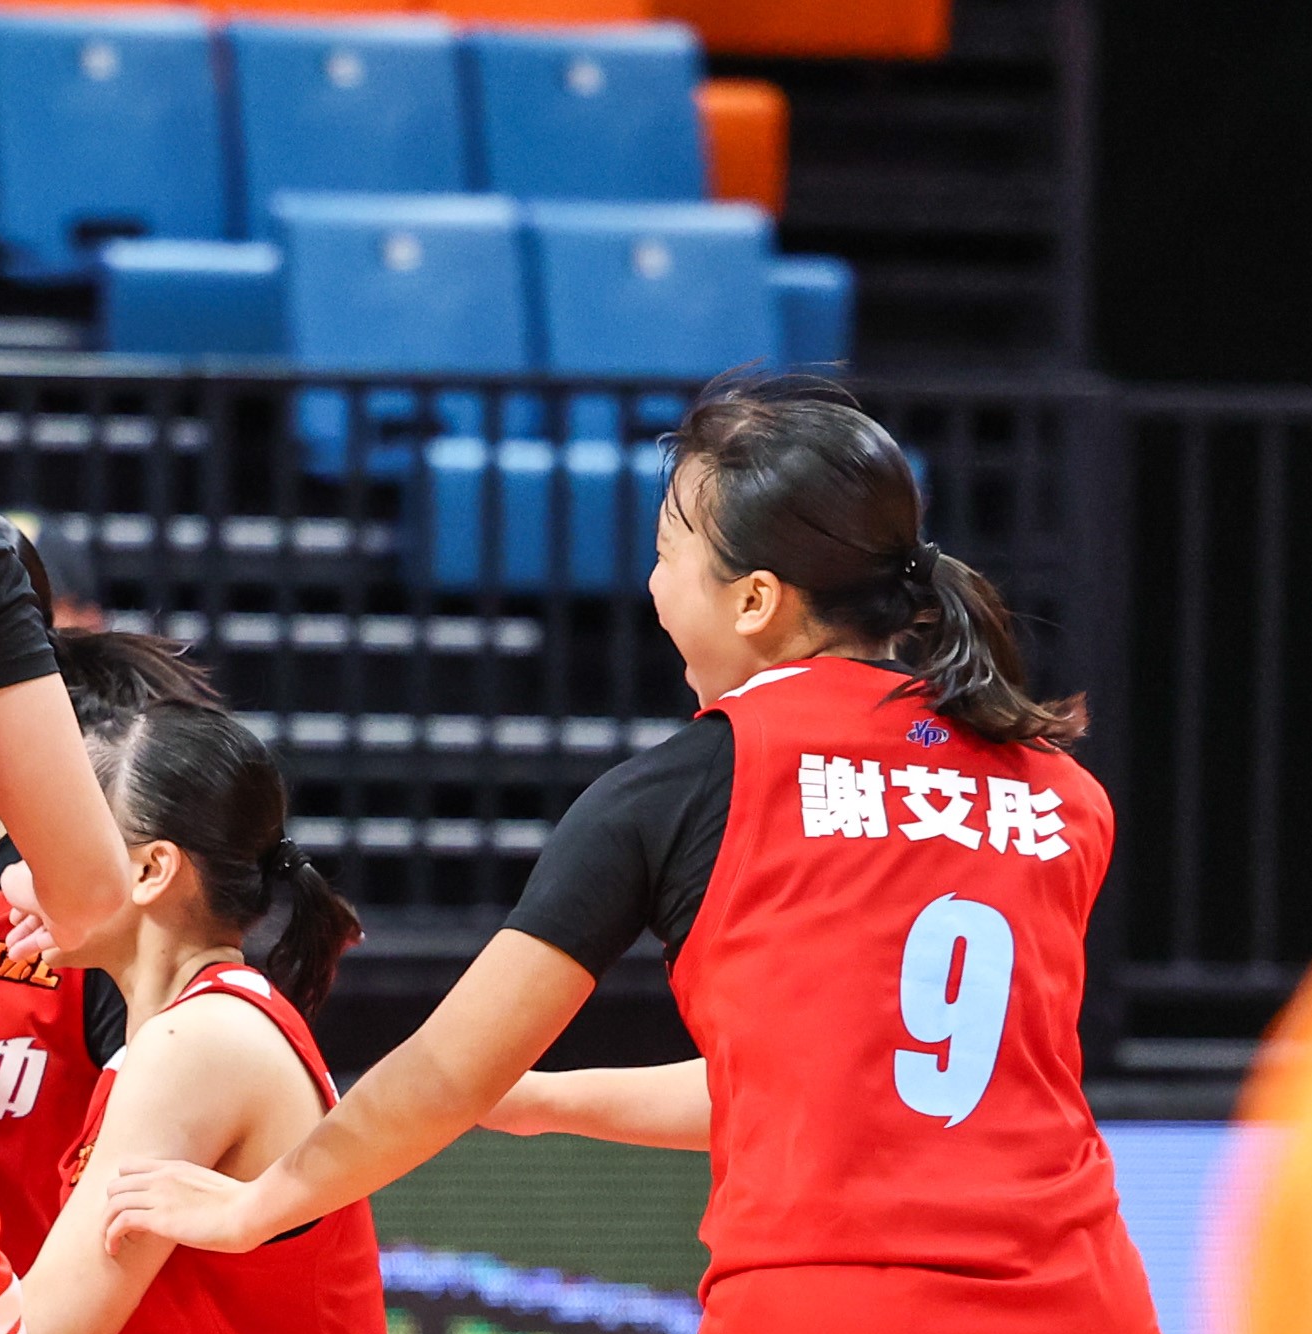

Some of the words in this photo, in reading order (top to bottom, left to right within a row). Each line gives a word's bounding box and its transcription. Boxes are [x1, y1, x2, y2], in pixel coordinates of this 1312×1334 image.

[798, 753, 1071, 861] 謝艾彤
[893, 892, 1015, 1128] 9
